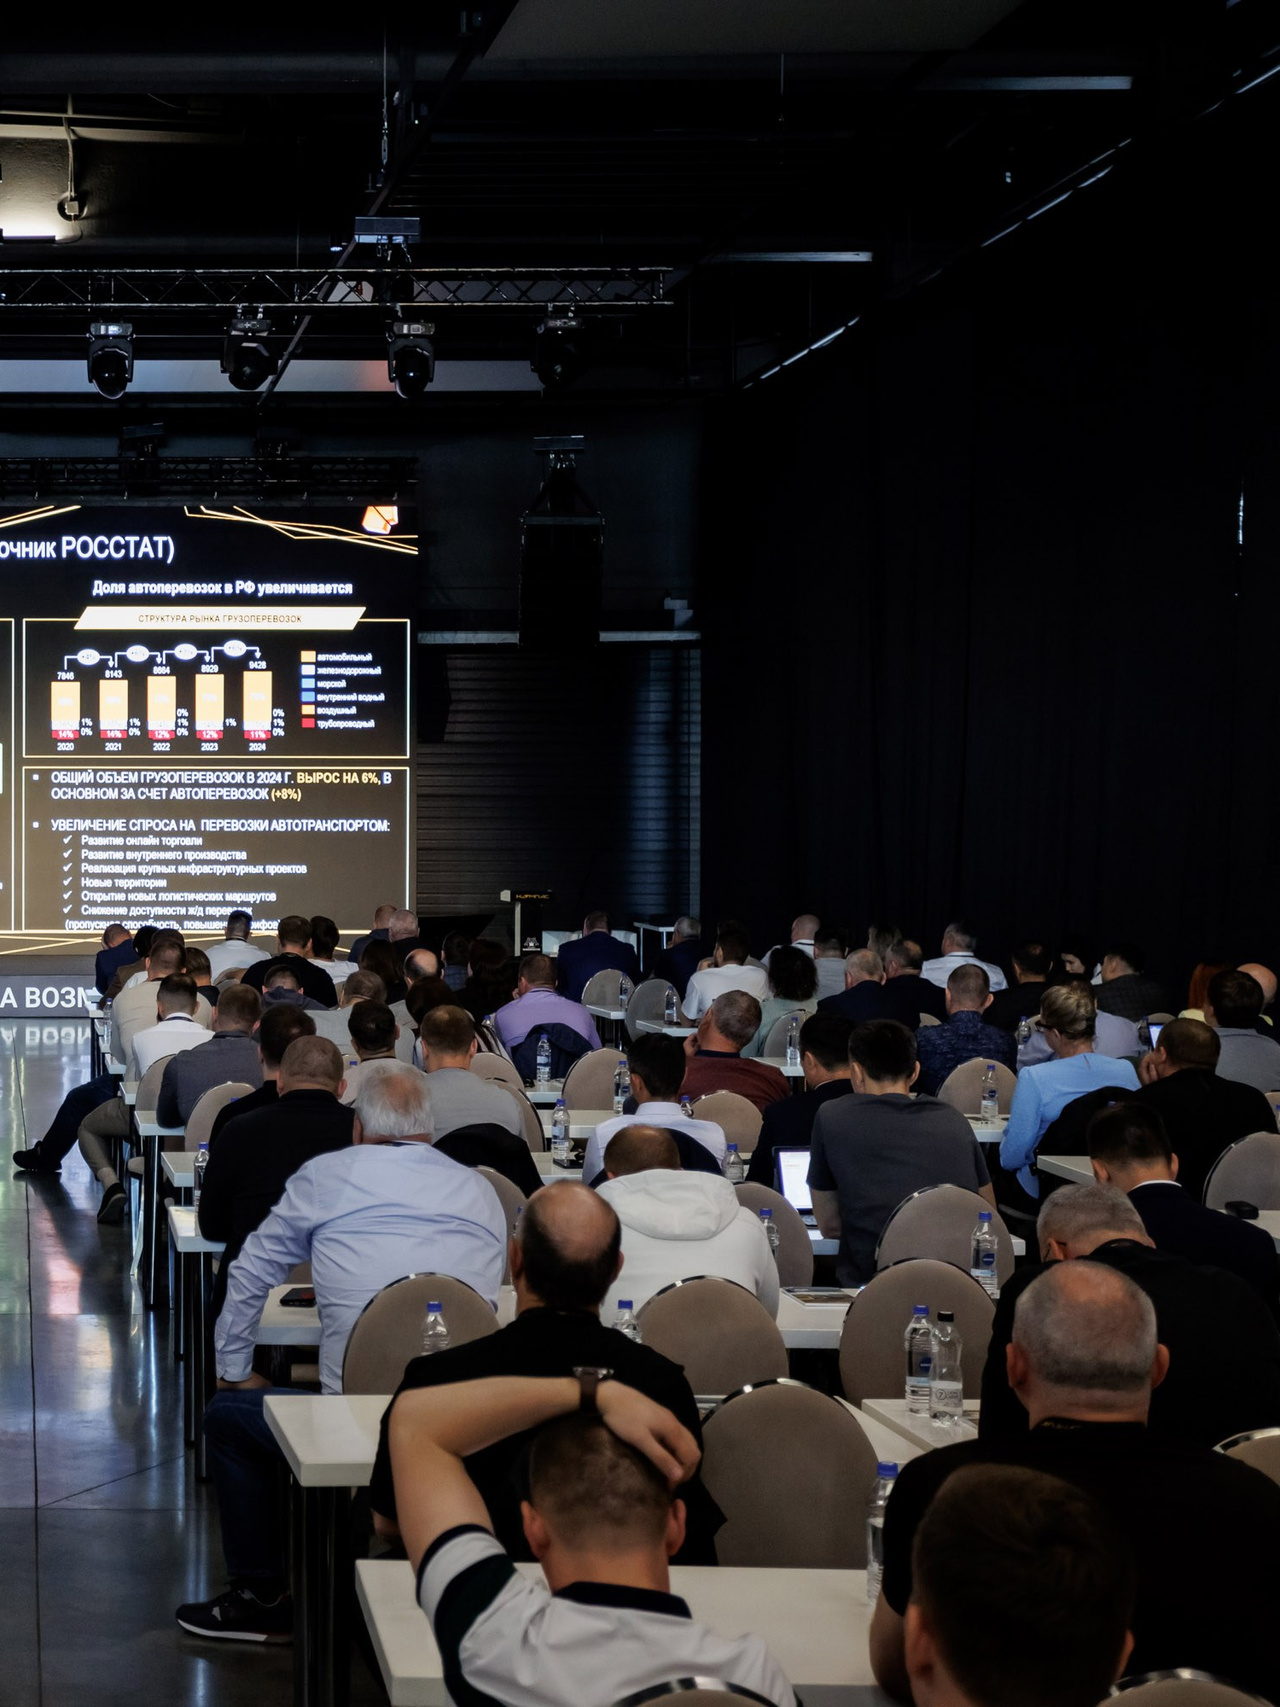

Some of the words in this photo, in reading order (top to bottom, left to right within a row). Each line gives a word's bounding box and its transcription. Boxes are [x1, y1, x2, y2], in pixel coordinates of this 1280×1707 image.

[62, 536, 174, 563] РОССТАТ)
[93, 580, 126, 596] Доля
[128, 583, 222, 596] автоперевозок
[224, 583, 233, 594] в
[235, 580, 256, 594] РФ
[258, 583, 353, 597] увеличивается
[138, 615, 187, 623] СТРУКТУРА
[189, 615, 220, 623] РЫНКА
[222, 615, 302, 623] ГРУЗОПЕРЕВОЗОК
[201, 665, 219, 673] 8929
[249, 661, 266, 669] 9428
[57, 671, 74, 680] 7846
[105, 670, 122, 678] 8143
[177, 709, 188, 717] 0%
[273, 709, 284, 717] 0%
[81, 718, 92, 727] 1%
[130, 718, 141, 727] 1%
[178, 718, 189, 727] 1%
[225, 718, 237, 727] 1%
[274, 718, 285, 727] 1%
[317, 720, 375, 729] трубопроводный
[58, 730, 74, 739] 14%
[81, 728, 92, 736] 0%
[106, 730, 122, 739] 14%
[129, 728, 140, 736] 0%
[154, 730, 170, 739] 12%
[177, 728, 188, 736] 0%
[202, 730, 218, 739] 12%
[250, 730, 266, 739] 11%
[273, 728, 285, 736] 0%
[57, 742, 74, 751] 2020
[105, 742, 122, 751] 2021
[153, 742, 170, 751] 2022
[201, 742, 218, 751] 2023
[249, 742, 266, 751] 2024
[51, 770, 94, 785] ОБЩИЙ
[96, 772, 138, 783] ОБЪЕМ
[141, 772, 244, 783] ГРУЗОПЕРЕВОЗОК
[247, 772, 255, 783] В
[257, 772, 282, 783] 2024
[297, 772, 340, 784] ВЫРОС
[343, 772, 359, 783] НА
[362, 772, 381, 785] 6%,
[383, 772, 392, 784] В
[51, 788, 118, 799] ОСНОВНОМ
[121, 788, 135, 799] ЗА
[138, 788, 168, 799] СЧЕТ
[170, 788, 269, 799] АВТОПЕРЕВОЗОК
[271, 788, 302, 802] (+8%)
[51, 819, 126, 831] УВЕЛИЧЕНИЕ
[129, 819, 177, 831] СПРОСА
[179, 819, 196, 831] НА
[201, 819, 269, 831] ПЕРЕВОЗКИ
[271, 819, 390, 831] АВТОТРАНСПОРТОМ:
[81, 835, 124, 846] Развитие
[126, 835, 159, 846] онлайн
[161, 837, 203, 848] торговли
[81, 849, 124, 860] Развитие
[126, 851, 182, 862] внутреннего
[184, 851, 247, 862] производства
[81, 863, 136, 875] Реализация
[138, 865, 176, 876] крупных
[178, 863, 264, 876] инфраструктурных
[265, 865, 307, 876] проектов
[81, 877, 112, 888] Новые
[114, 879, 167, 889] территории
[81, 891, 126, 903] Открытие
[128, 893, 156, 901] новых
[158, 893, 223, 901] логистических
[225, 893, 277, 903] маршрутов
[81, 905, 128, 916] Снижение
[129, 907, 186, 918] доступности
[188, 906, 204, 917] ж/д
